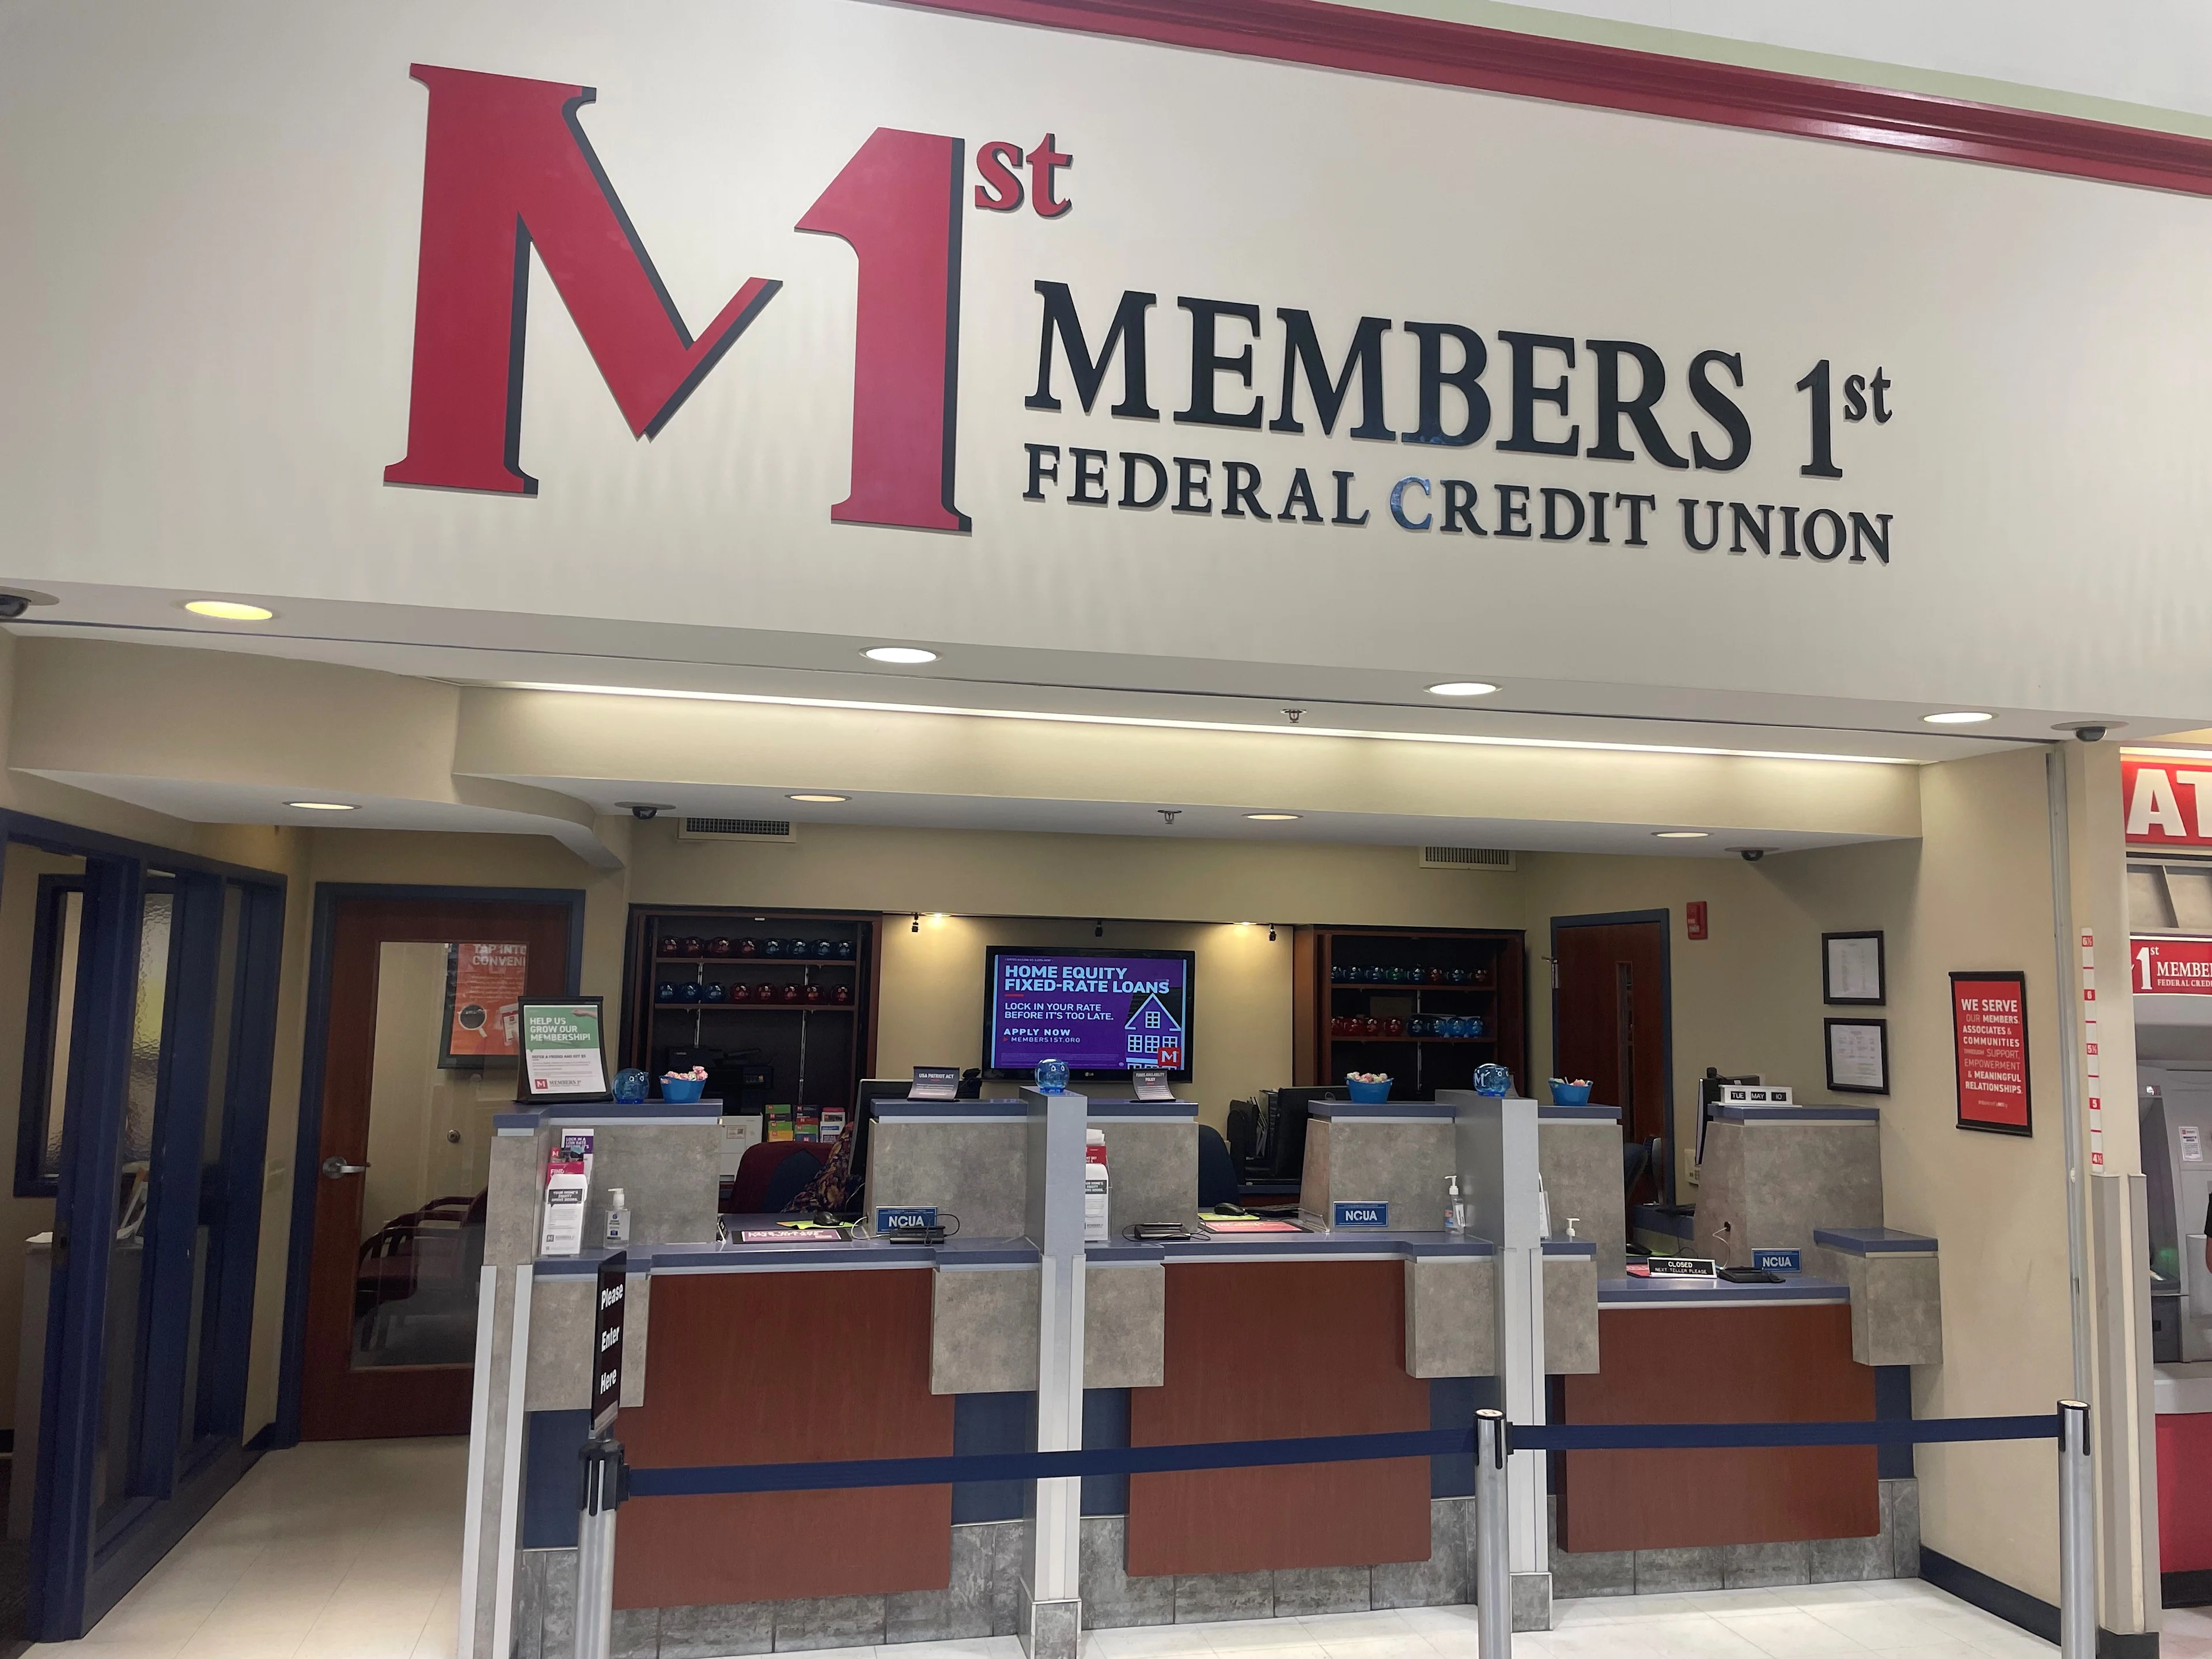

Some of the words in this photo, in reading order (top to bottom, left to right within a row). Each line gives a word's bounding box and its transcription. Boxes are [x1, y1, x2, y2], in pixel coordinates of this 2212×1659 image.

[1024, 280, 1752, 471] MEMBERS
[1796, 359, 1893, 478] 1st
[1022, 443, 1370, 525] FEDERAL
[1389, 475, 1656, 546] CREDIT
[1678, 498, 1893, 563] UNION
[473, 944, 496, 954] TAP
[1005, 965, 1058, 978] HOME
[1063, 966, 1127, 979] EQUITY
[2157, 961, 2212, 978] MEMBE
[1005, 979, 1108, 993] FIXED-RATE
[1112, 981, 1169, 994] LOANS
[2087, 990, 2092, 1000] 6
[1046, 1003, 1074, 1011] YOUR
[1961, 998, 1979, 1011] WE
[1982, 999, 2017, 1012] SERVE
[1046, 1012, 1063, 1020] IT'S
[1065, 1012, 1085, 1020] TOO
[1088, 1013, 1113, 1021] LATE.
[1966, 1014, 1980, 1022] OUR
[530, 1025, 557, 1033] GROW
[1963, 1025, 2006, 1035] ASSOCIATES
[531, 1033, 590, 1041] MEMBERSHIP!
[1963, 1036, 2020, 1047] COMMUNITIES
[1964, 1058, 2020, 1070] EMPOWERMENT
[1974, 1071, 2021, 1082] MEANINGFUL
[2093, 1099, 2097, 1108] 5
[889, 1215, 925, 1227] NCUA
[1346, 1210, 1377, 1221] NCUA
[1763, 1256, 1792, 1267] NCUA
[601, 1283, 623, 1310] Please
[601, 1326, 620, 1353] Enter
[600, 1369, 617, 1395] Here
